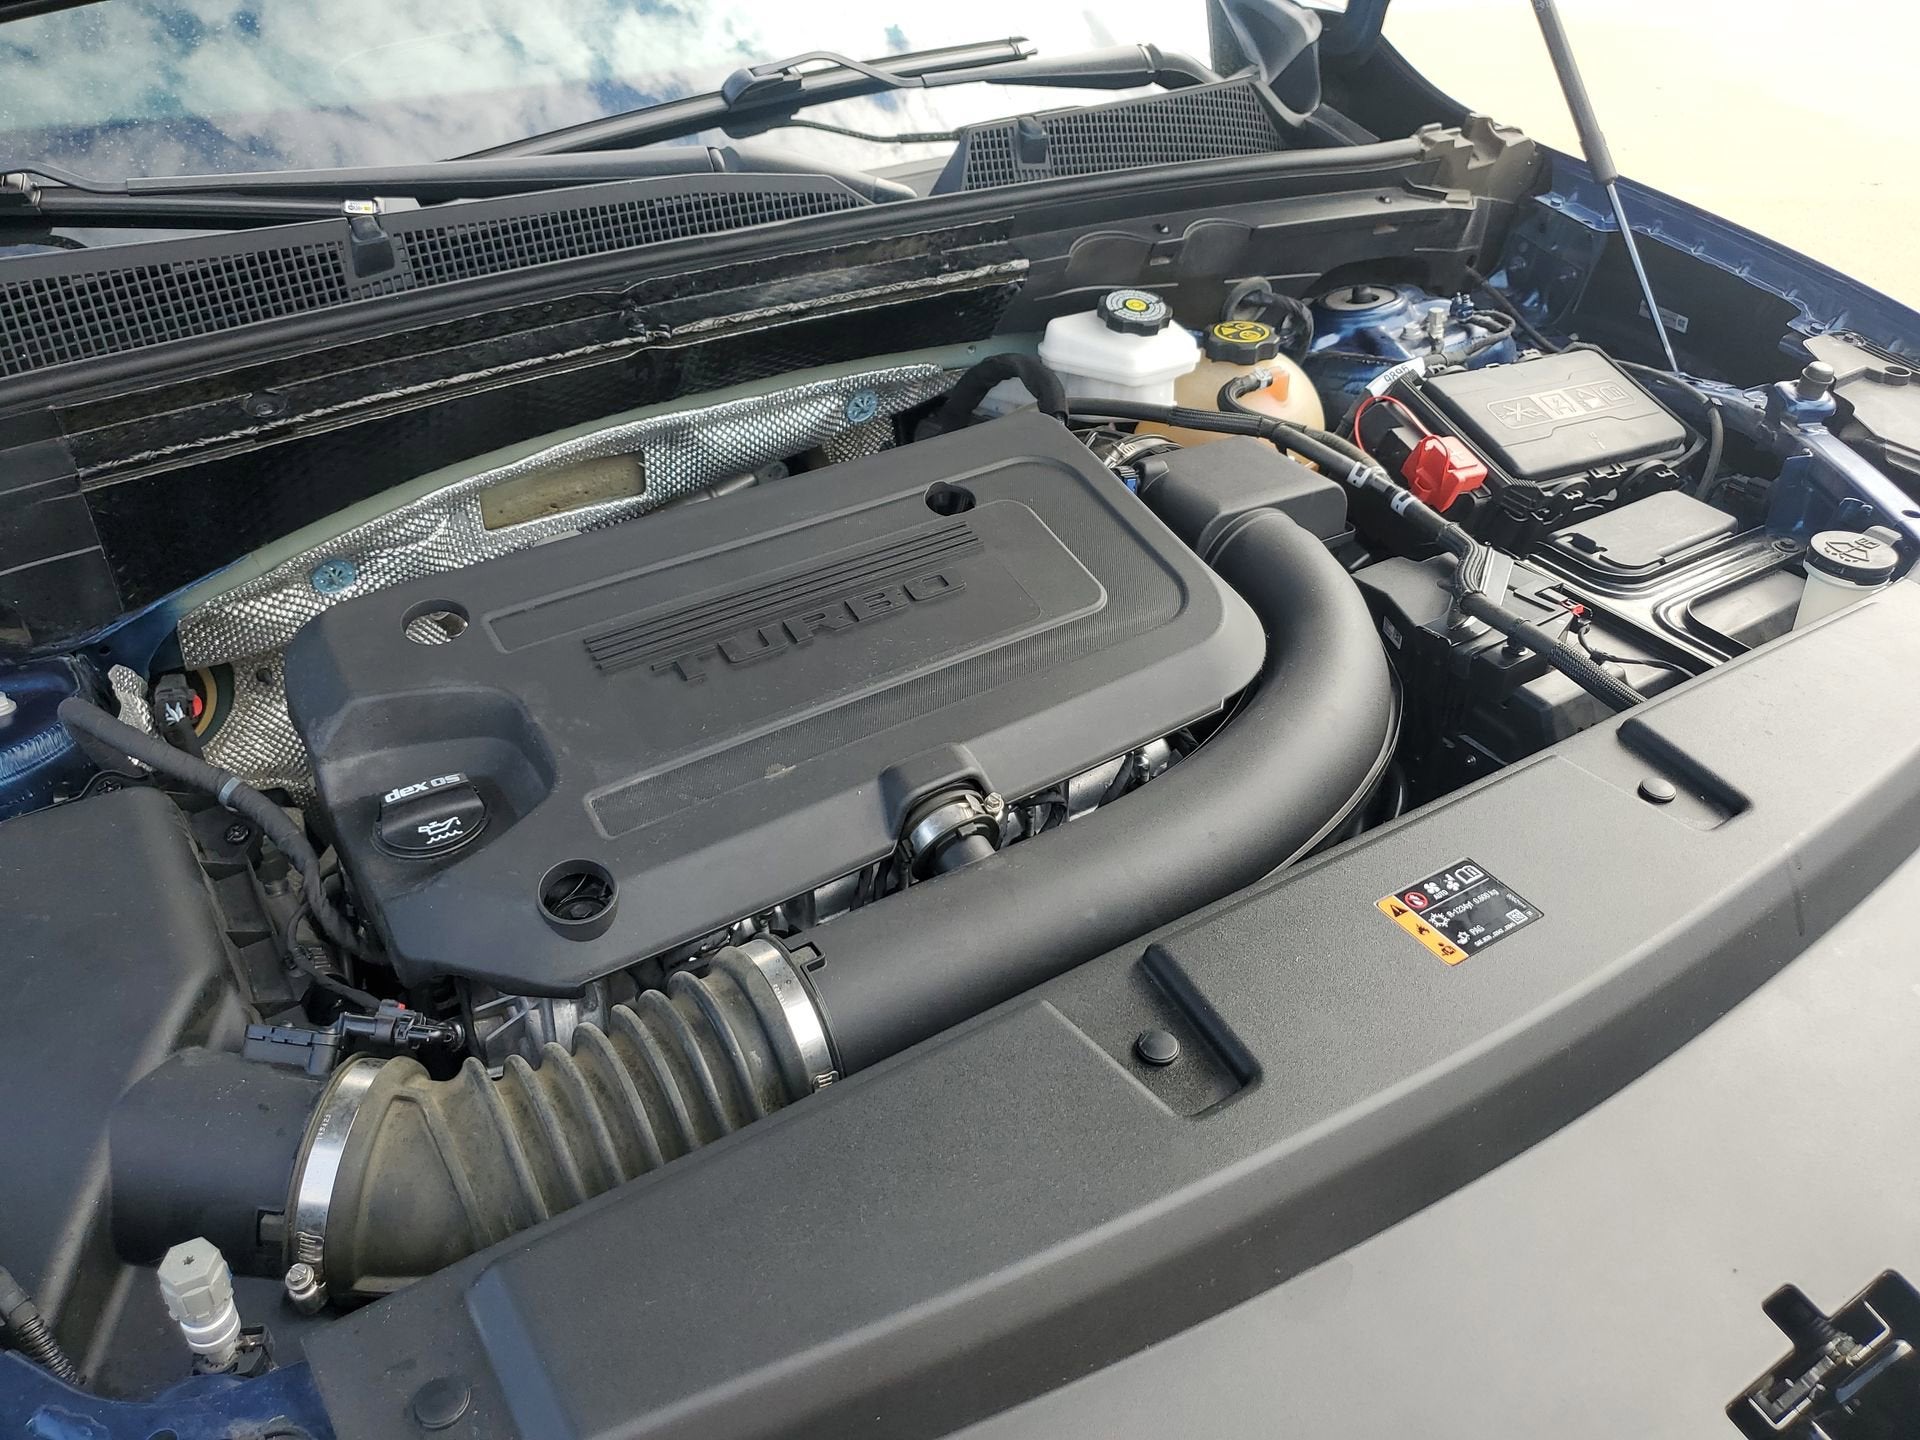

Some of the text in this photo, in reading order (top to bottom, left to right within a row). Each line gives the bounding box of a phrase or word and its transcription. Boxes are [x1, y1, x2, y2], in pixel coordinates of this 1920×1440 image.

[651, 567, 966, 682] TURBO
[1433, 889, 1449, 900] AUTO
[1469, 924, 1485, 936] PAG
